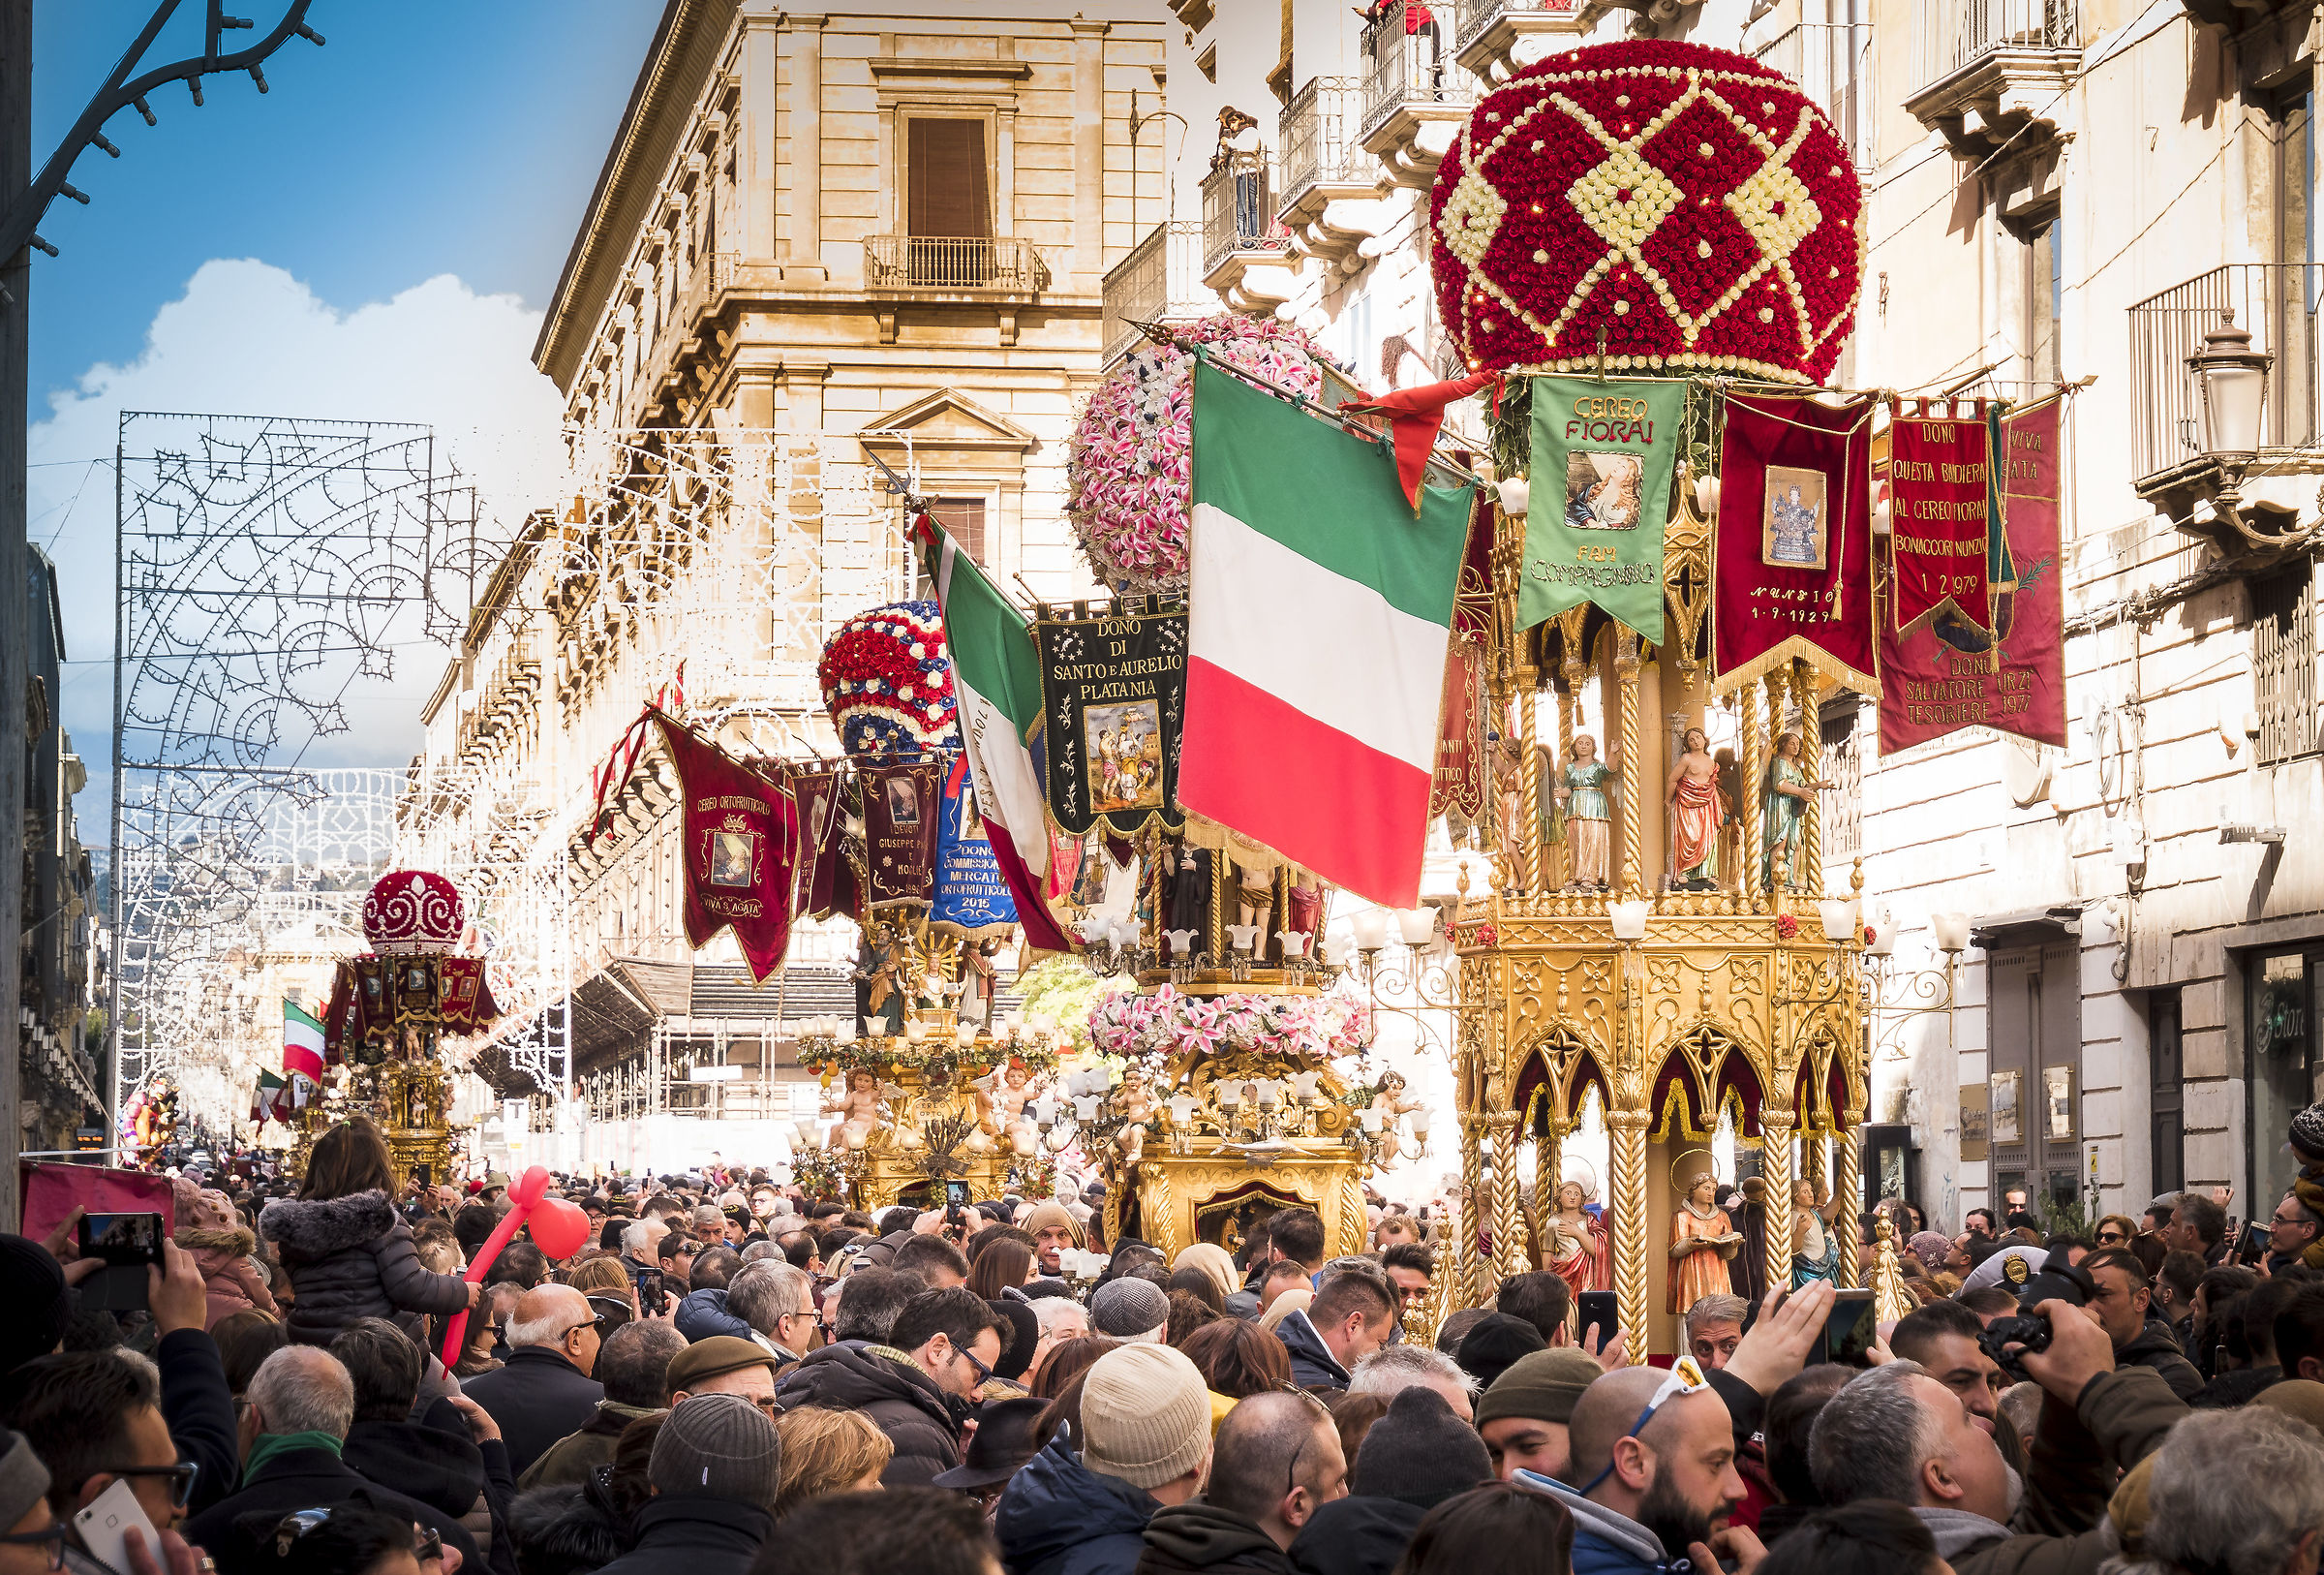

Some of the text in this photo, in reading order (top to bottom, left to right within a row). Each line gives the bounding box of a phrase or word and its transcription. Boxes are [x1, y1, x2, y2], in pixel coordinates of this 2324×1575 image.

[1574, 396, 1648, 422] CEREO
[1566, 420, 1654, 445] FIORAI
[1922, 423, 1955, 444] DONO
[2011, 430, 2041, 450] VIVA
[1893, 459, 1935, 482] QUESTA
[2001, 459, 2037, 479] GATA
[1894, 497, 1909, 517] AL
[1913, 500, 1951, 521] CEREO
[1576, 544, 1616, 562] FAM
[1921, 572, 1978, 596] 1 2 1979
[1097, 619, 1141, 637] DONO
[1109, 639, 1127, 657] DI
[1054, 654, 1182, 680] SANTO E AURELIO
[1951, 656, 1993, 676] DONO
[1081, 679, 1156, 700] PLATANIA
[1906, 680, 1987, 701] SALVATORE
[1908, 701, 1991, 726] TESORIERE
[697, 795, 771, 816] CEREO ORTOFRUTTICOLO
[878, 838, 914, 849] GIUSEPPE
[950, 871, 1000, 882] MERCAT
[704, 898, 721, 910] VIVA
[731, 902, 759, 913] AGATA
[962, 897, 990, 909] 2015
